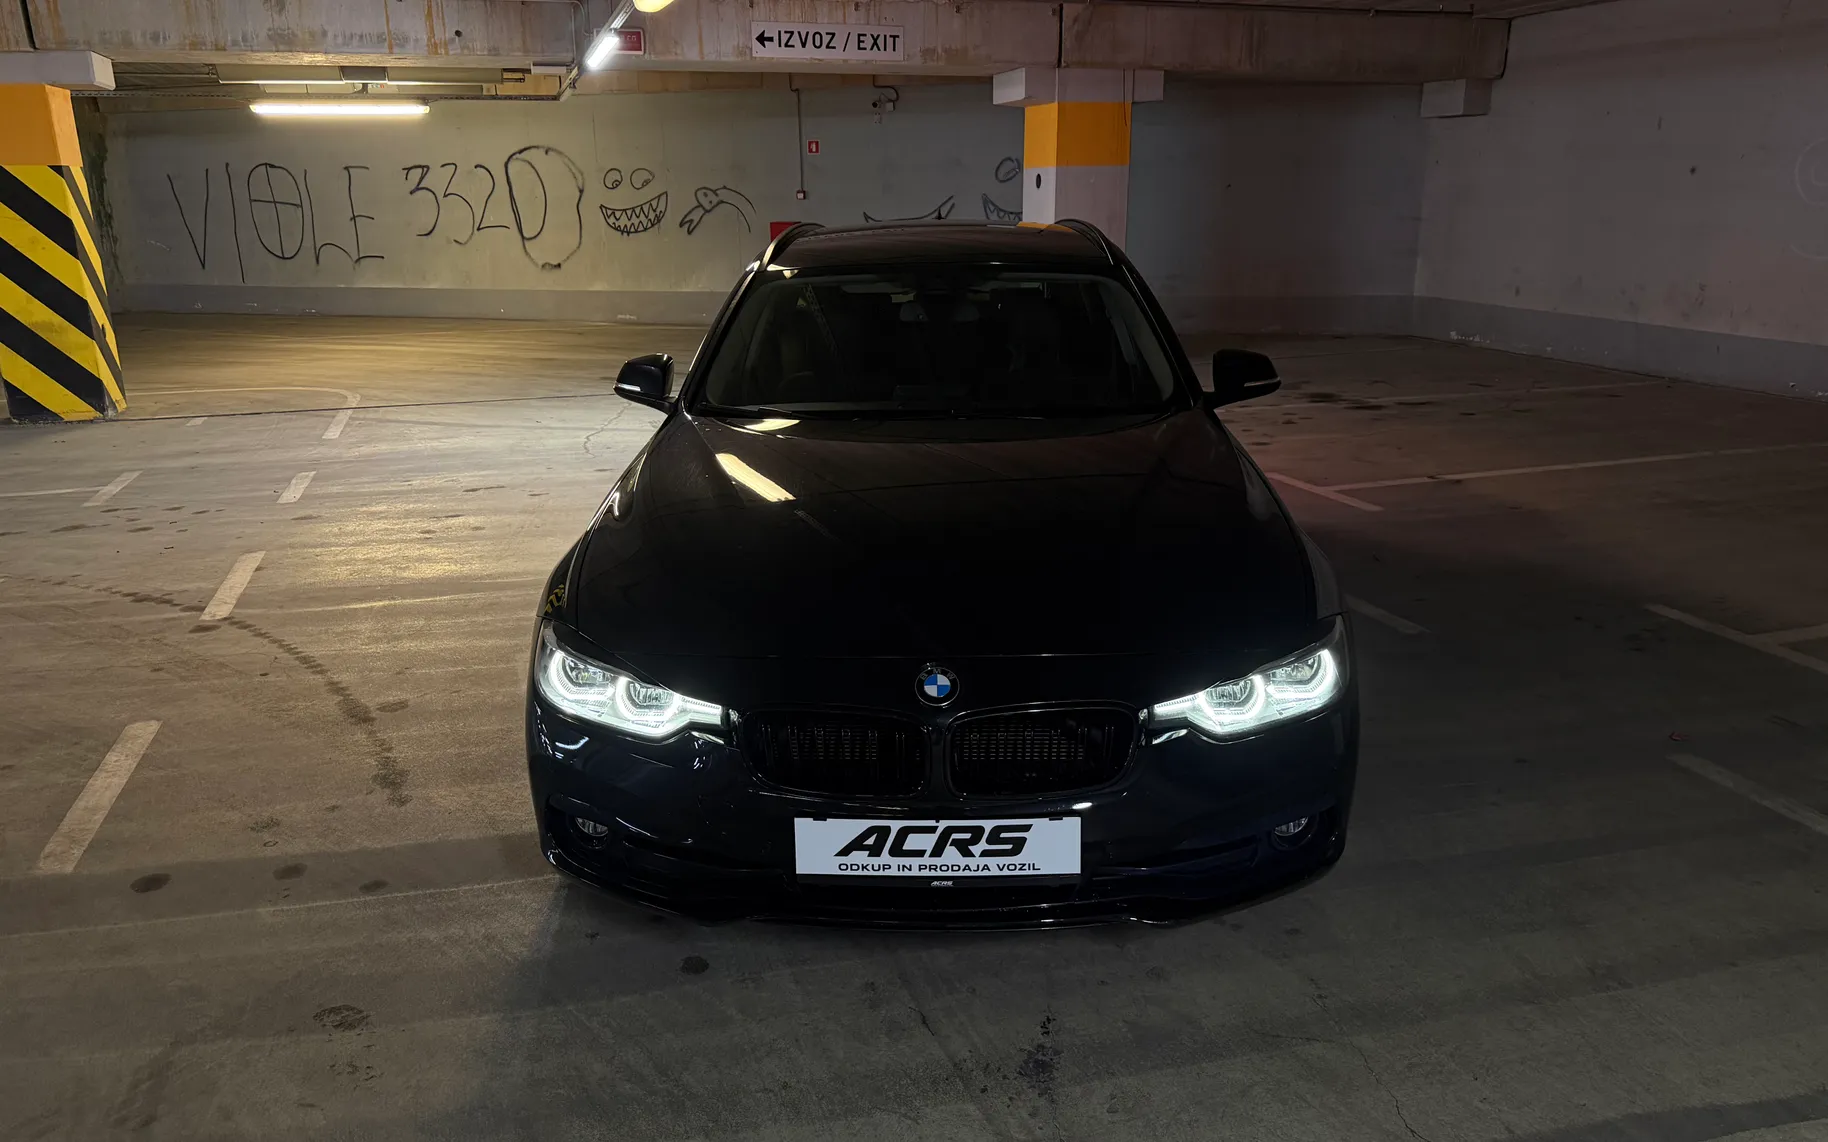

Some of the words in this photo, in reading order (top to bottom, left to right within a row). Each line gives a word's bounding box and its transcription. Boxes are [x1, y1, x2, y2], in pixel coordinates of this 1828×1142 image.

[777, 30, 837, 50] IZVOZ
[842, 31, 851, 52] /
[857, 33, 900, 53] EXIT
[833, 823, 1034, 858] ACRS
[837, 863, 892, 873] ODKUP
[897, 863, 913, 873] IN
[918, 863, 991, 873] PRODAJA
[996, 862, 1041, 872] VOZIL
